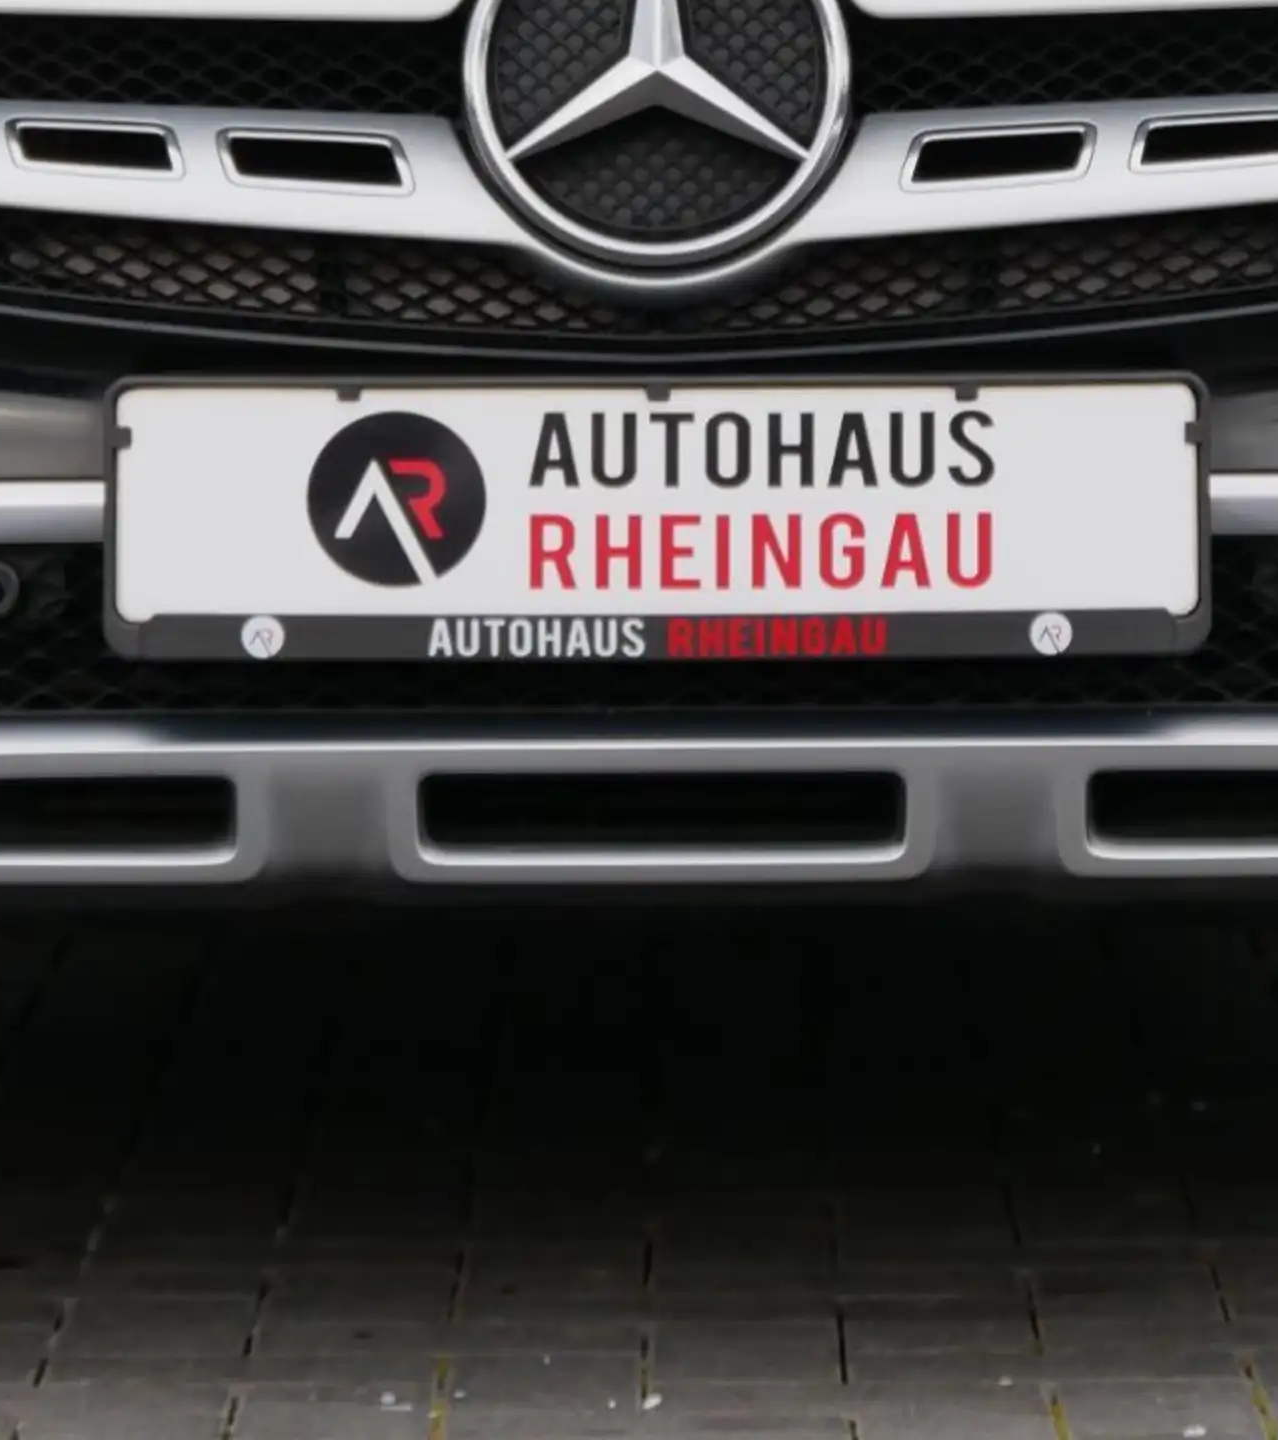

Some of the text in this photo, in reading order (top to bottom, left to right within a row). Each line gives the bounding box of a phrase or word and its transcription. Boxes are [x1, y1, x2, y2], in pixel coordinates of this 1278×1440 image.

[529, 410, 995, 488] AUTOHAUS
[529, 513, 992, 590] RHEINGAU
[428, 617, 887, 658] AUTOHAUS RHEINGAU
